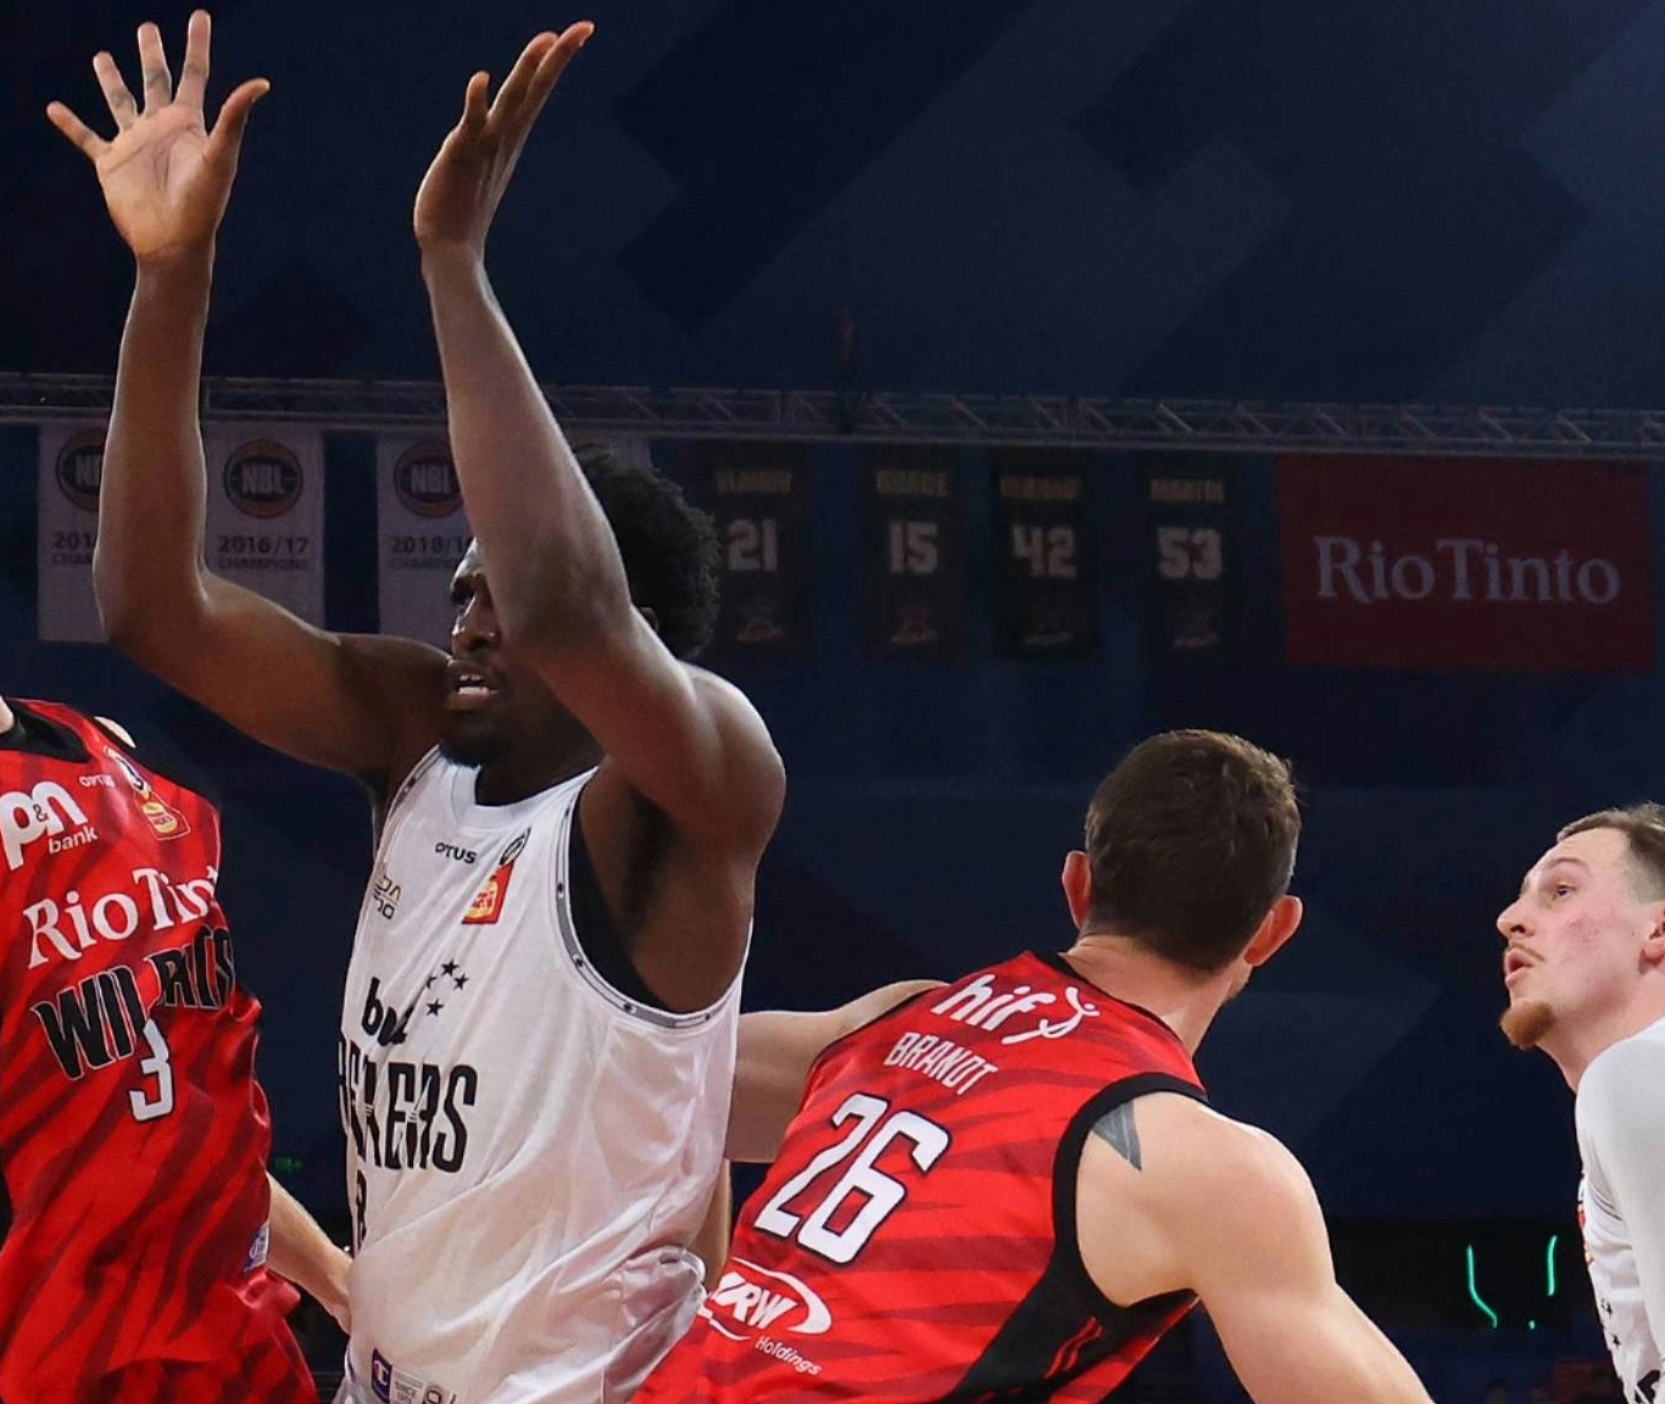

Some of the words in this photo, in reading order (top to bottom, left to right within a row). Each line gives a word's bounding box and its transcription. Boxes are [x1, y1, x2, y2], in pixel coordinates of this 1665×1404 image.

[242, 473, 285, 495] NBL
[218, 536, 307, 555] 2016/17
[727, 518, 777, 572] 21
[888, 520, 938, 575] 15
[1010, 523, 1076, 578] 42
[1156, 526, 1222, 580] 53
[48, 825, 98, 854] bank
[129, 1019, 174, 1122] 3
[883, 1032, 999, 1096] BRANDT
[753, 1092, 950, 1265] 26
[755, 1336, 822, 1375] Holdings
